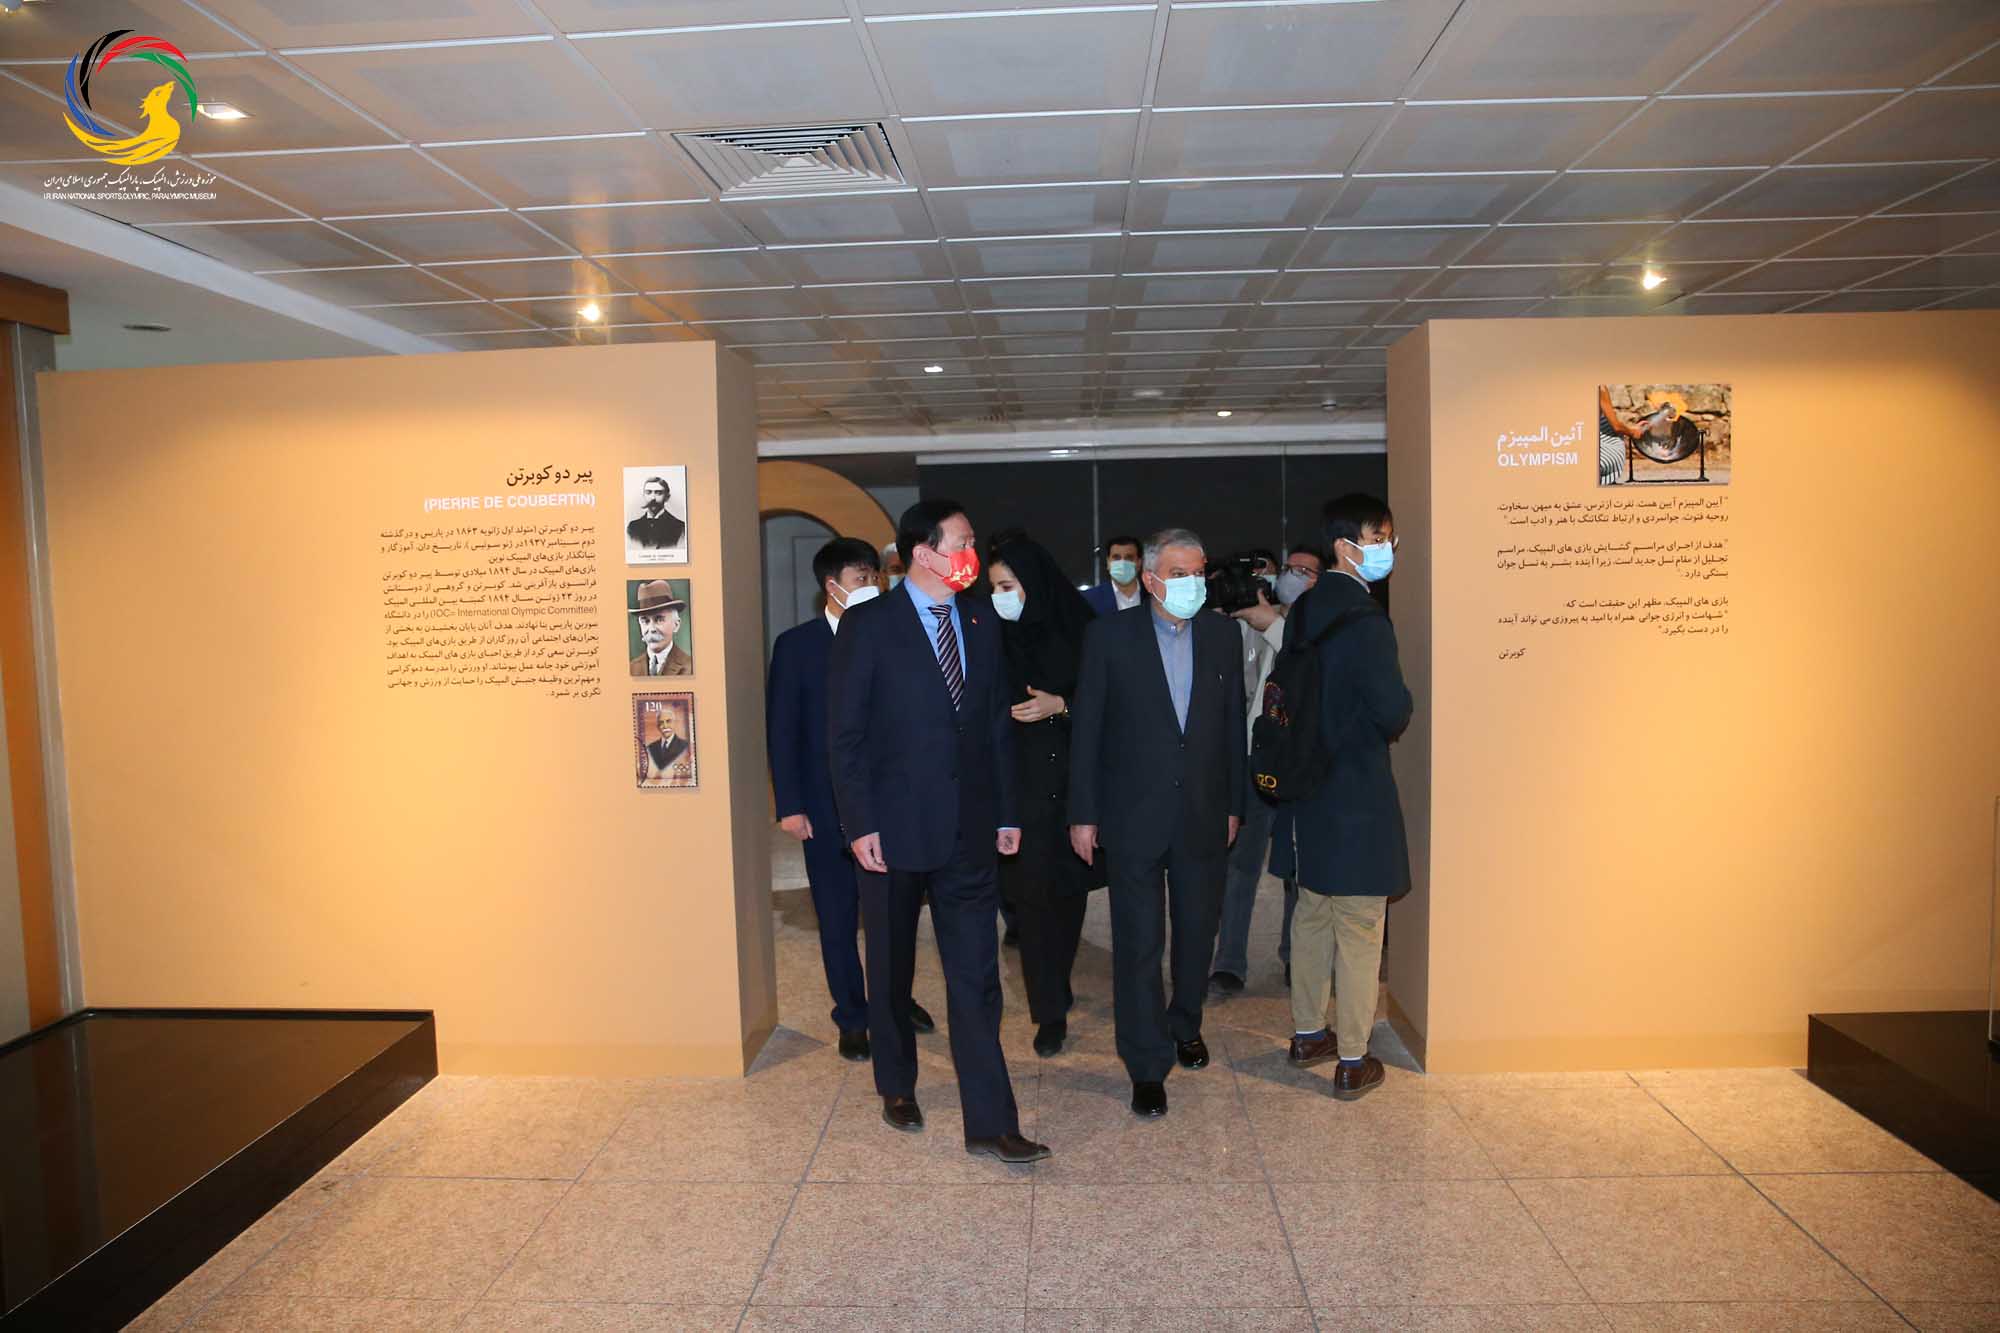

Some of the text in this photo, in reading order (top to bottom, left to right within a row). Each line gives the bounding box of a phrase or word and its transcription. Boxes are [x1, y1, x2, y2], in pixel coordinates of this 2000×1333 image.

[1496, 424, 1548, 453] المپیزم
[1497, 451, 1578, 466] OLYMPISM
[506, 464, 593, 486] پیر دو کوبرتن
[424, 492, 596, 512] (PIERRE DE COUBERTIN)
[1498, 647, 1527, 660] کوبرتن
[645, 701, 663, 712] 120
